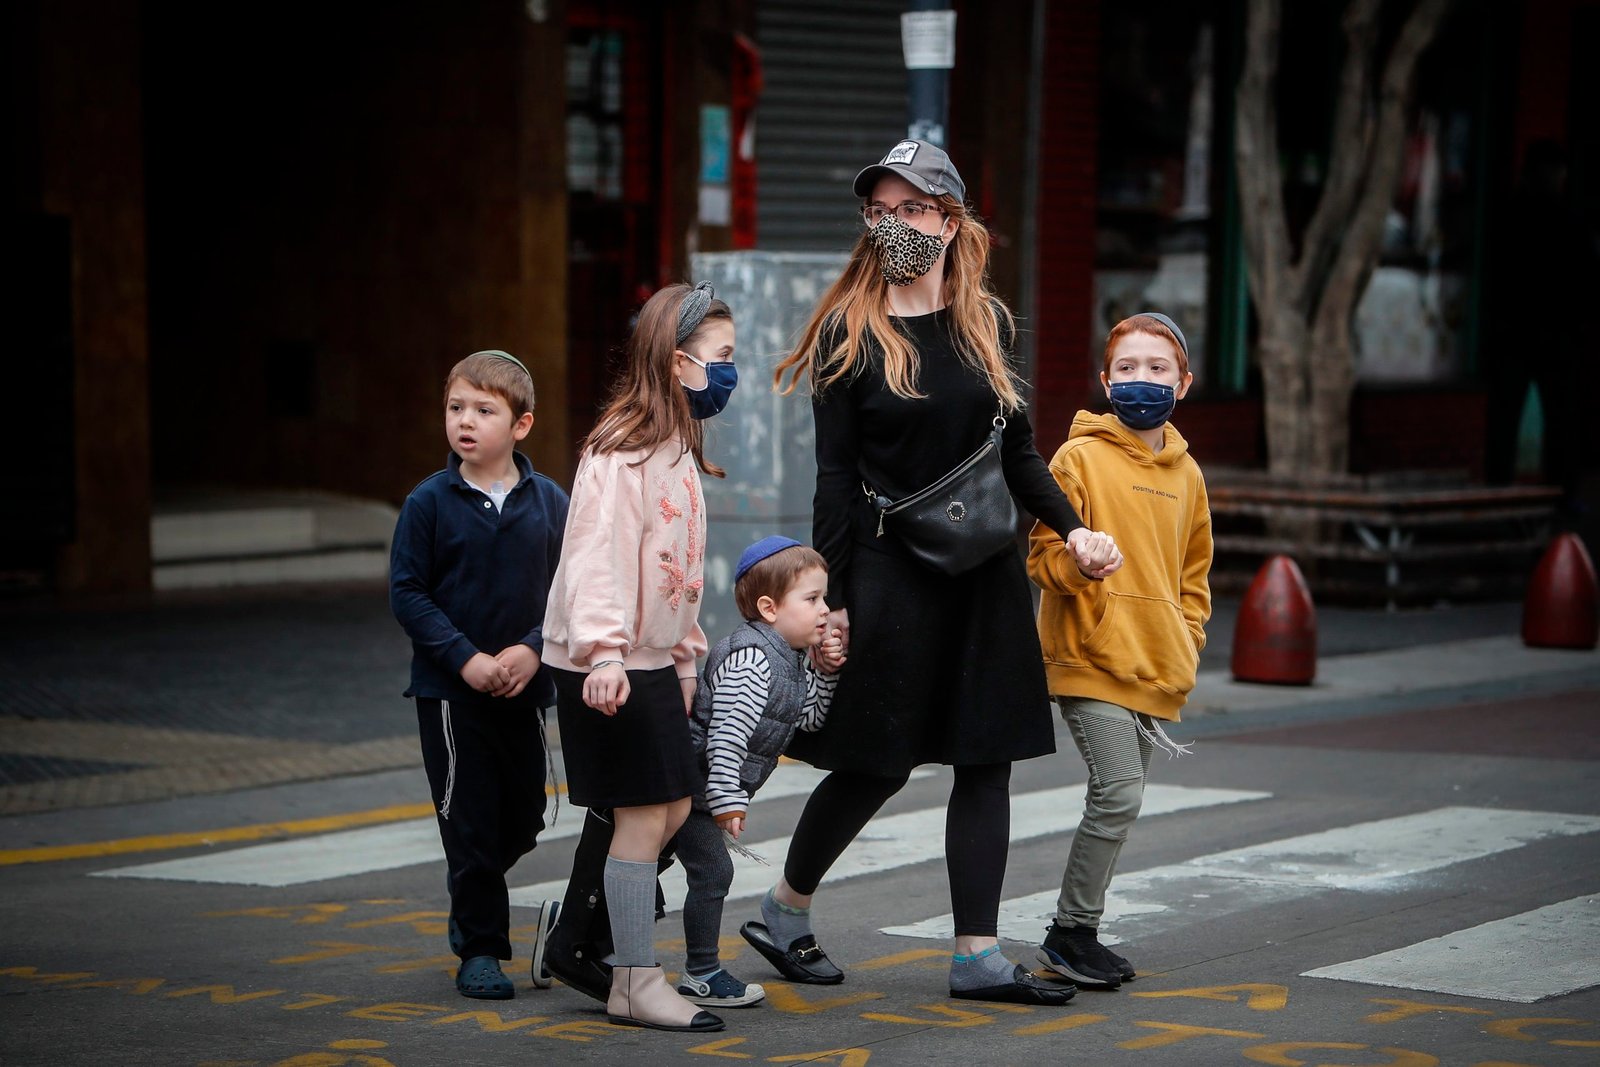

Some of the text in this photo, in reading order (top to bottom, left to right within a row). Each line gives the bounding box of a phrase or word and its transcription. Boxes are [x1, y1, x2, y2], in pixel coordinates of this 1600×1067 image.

[1132, 485, 1155, 494] POSITIVE
[1166, 493, 1178, 501] HAPPY
[686, 1036, 872, 1067] LA
